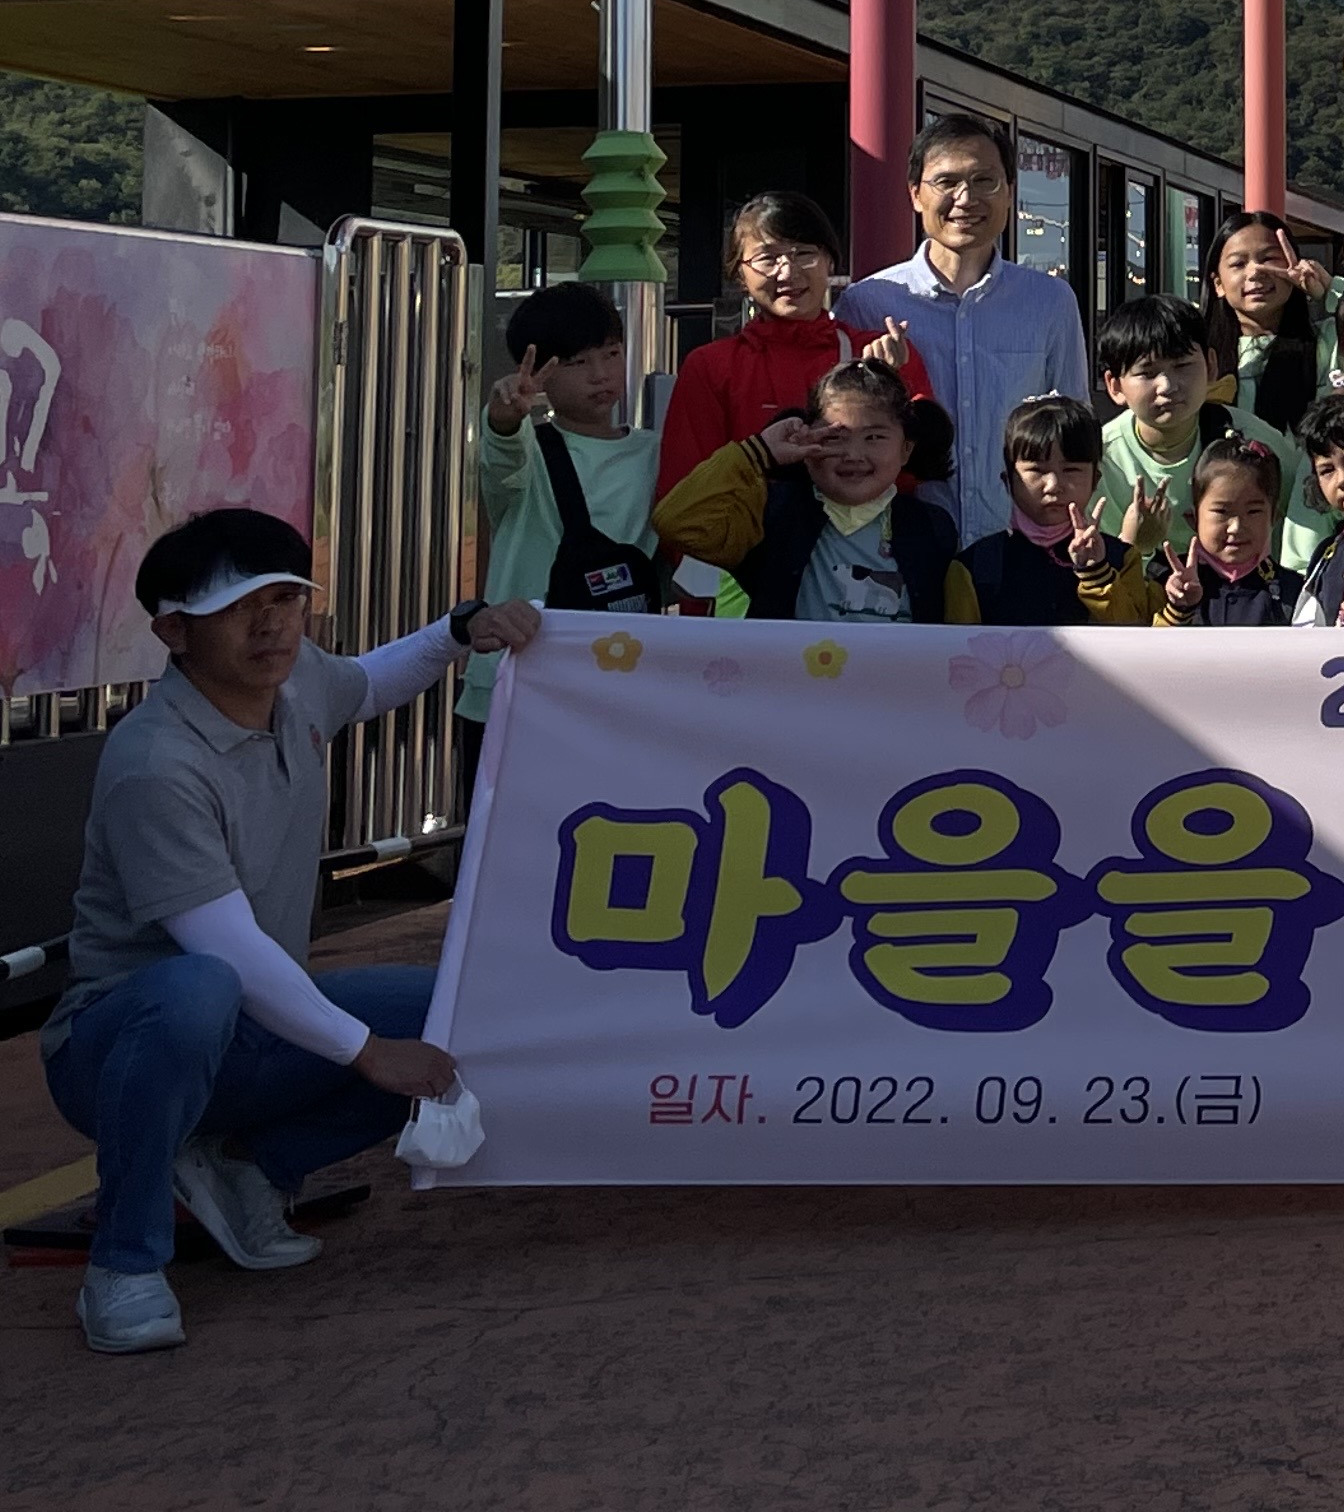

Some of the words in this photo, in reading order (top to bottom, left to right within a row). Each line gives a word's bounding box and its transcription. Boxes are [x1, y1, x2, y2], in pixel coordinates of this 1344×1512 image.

[648, 1073, 767, 1126] 일자.
[792, 1074, 950, 1125] 2022.
[974, 1074, 1058, 1125] 09.
[1081, 1073, 1263, 1127] 23.(금)
